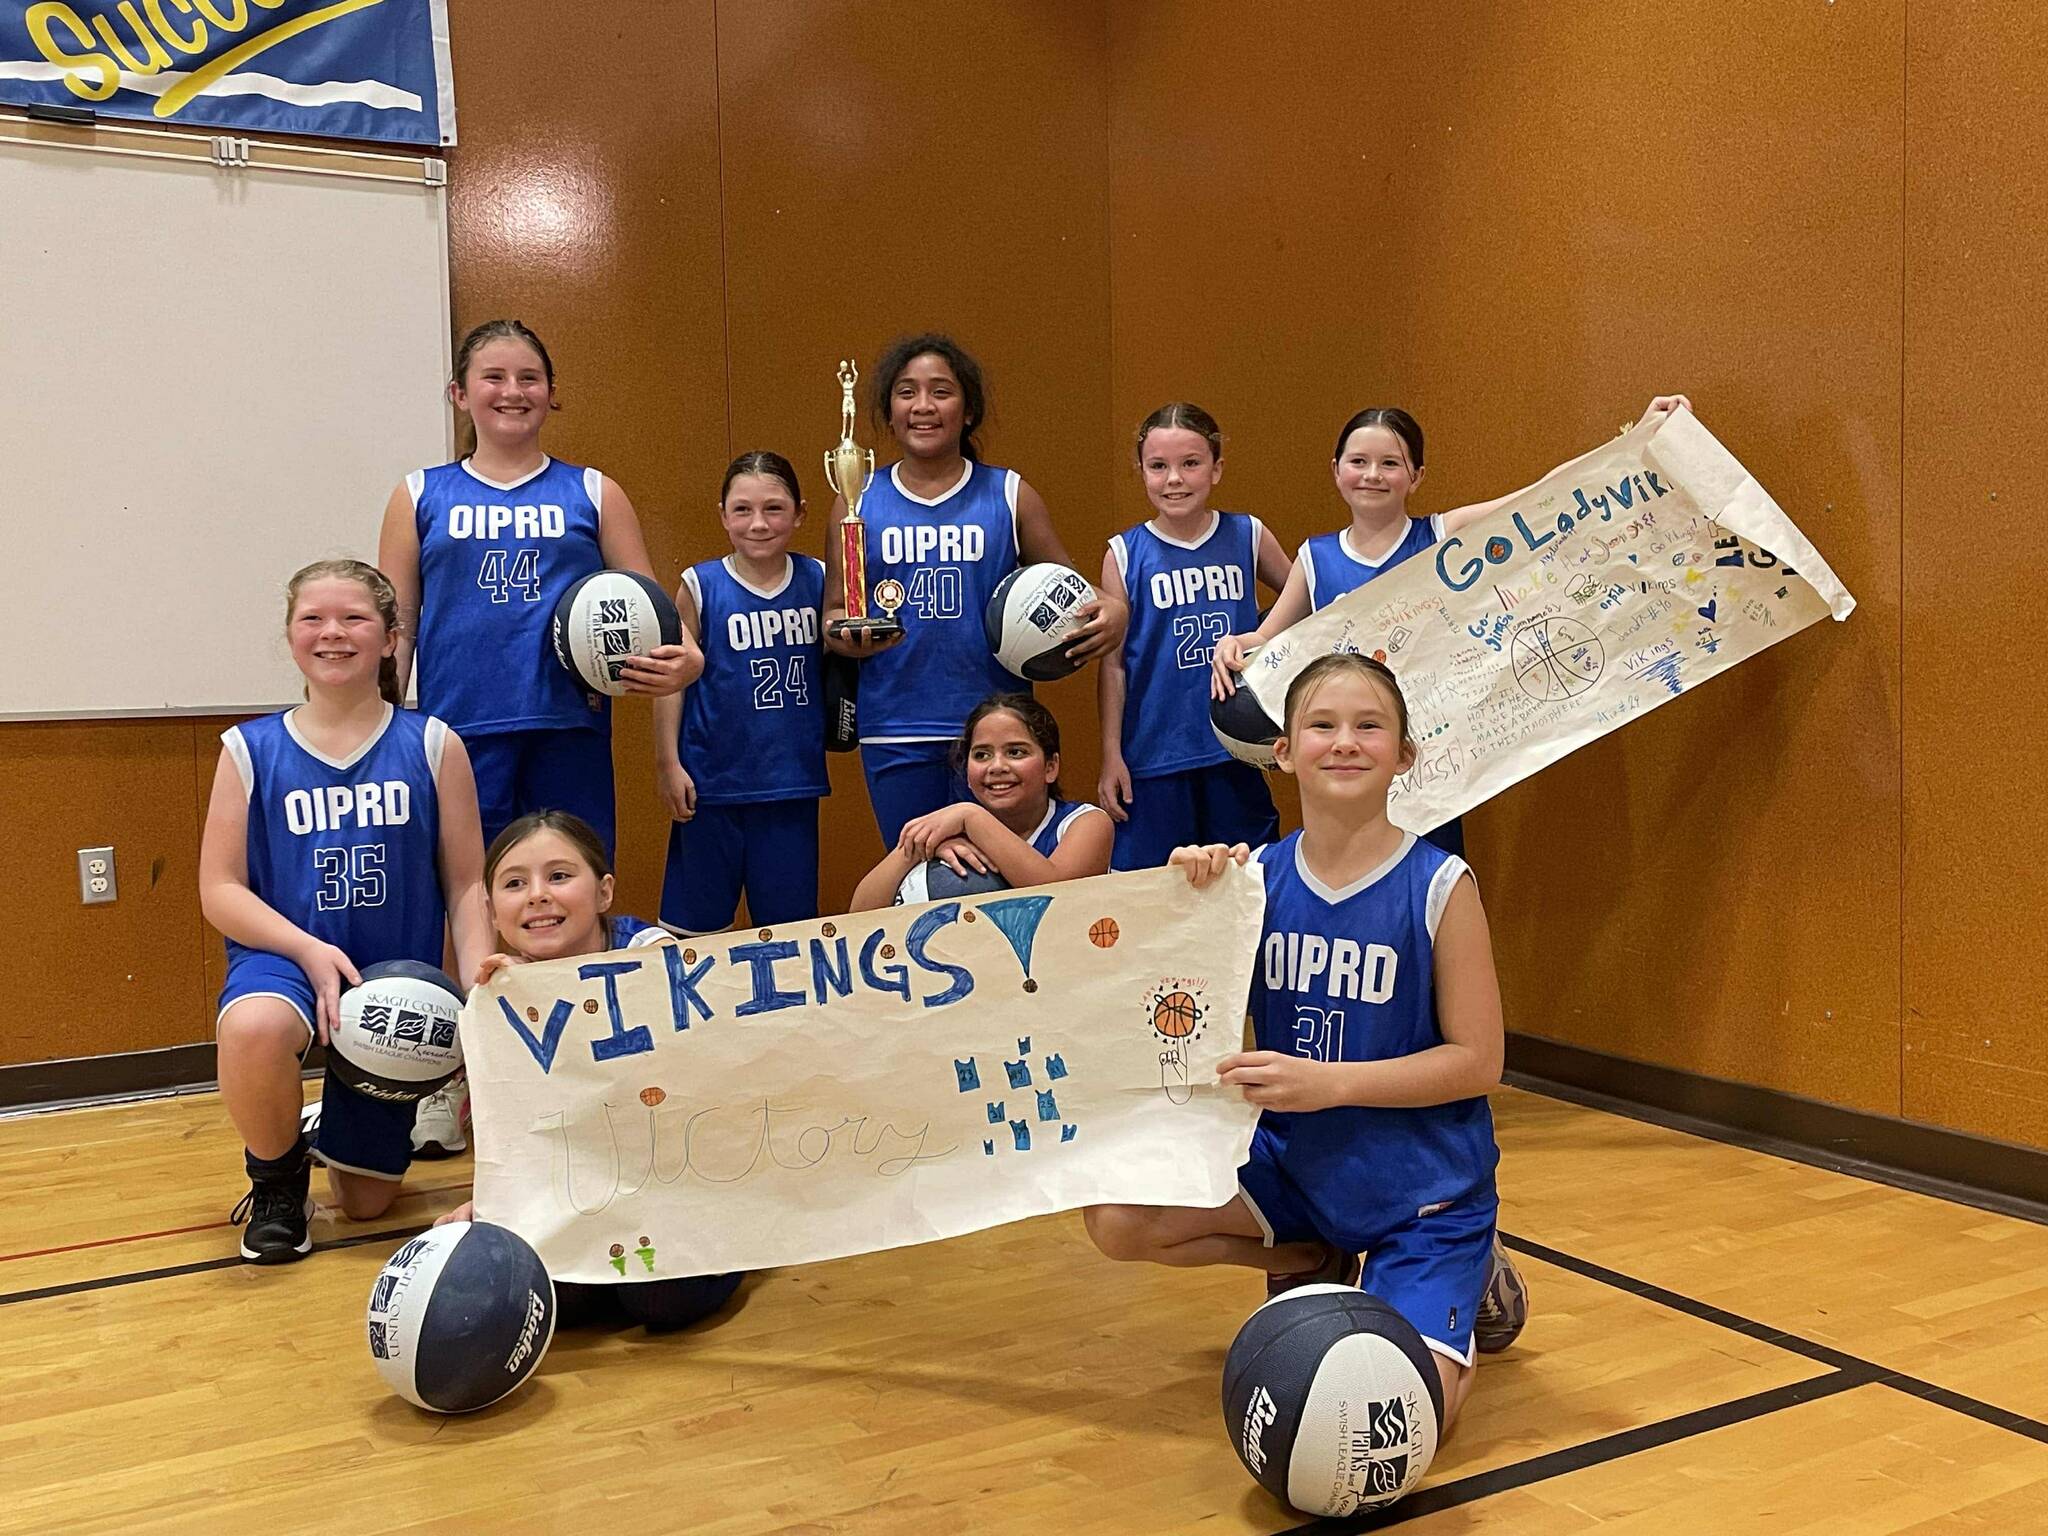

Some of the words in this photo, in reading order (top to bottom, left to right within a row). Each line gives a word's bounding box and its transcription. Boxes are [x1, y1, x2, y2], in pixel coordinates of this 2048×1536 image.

[448, 504, 565, 540] OIPRD
[881, 524, 985, 565] OIPRD
[1436, 536, 1513, 592] Go
[1512, 488, 1612, 551] Lady
[477, 548, 541, 604] 44
[907, 567, 963, 619] 40
[1150, 565, 1244, 609] OIPRD
[727, 606, 817, 652] OIPRD
[1174, 611, 1231, 670] 23
[1623, 637, 1675, 671] Vikings
[750, 655, 809, 710] 24
[841, 697, 856, 742] Baden
[1476, 725, 1507, 743] MAKE
[284, 780, 410, 836] OIPRD
[314, 843, 387, 912] 35
[1265, 931, 1399, 1004] OIPRD
[366, 992, 409, 1008] SKAGIT
[369, 1031, 399, 1050] Parks
[388, 1290, 405, 1359] COUNTY
[508, 1291, 546, 1374] Baden
[1247, 1386, 1279, 1476] Baden
[1338, 1401, 1349, 1443] SWISH
[1403, 1390, 1424, 1459] SKAGIT
[1335, 1441, 1348, 1484] LEAGUE
[1350, 1430, 1374, 1473] Parks
